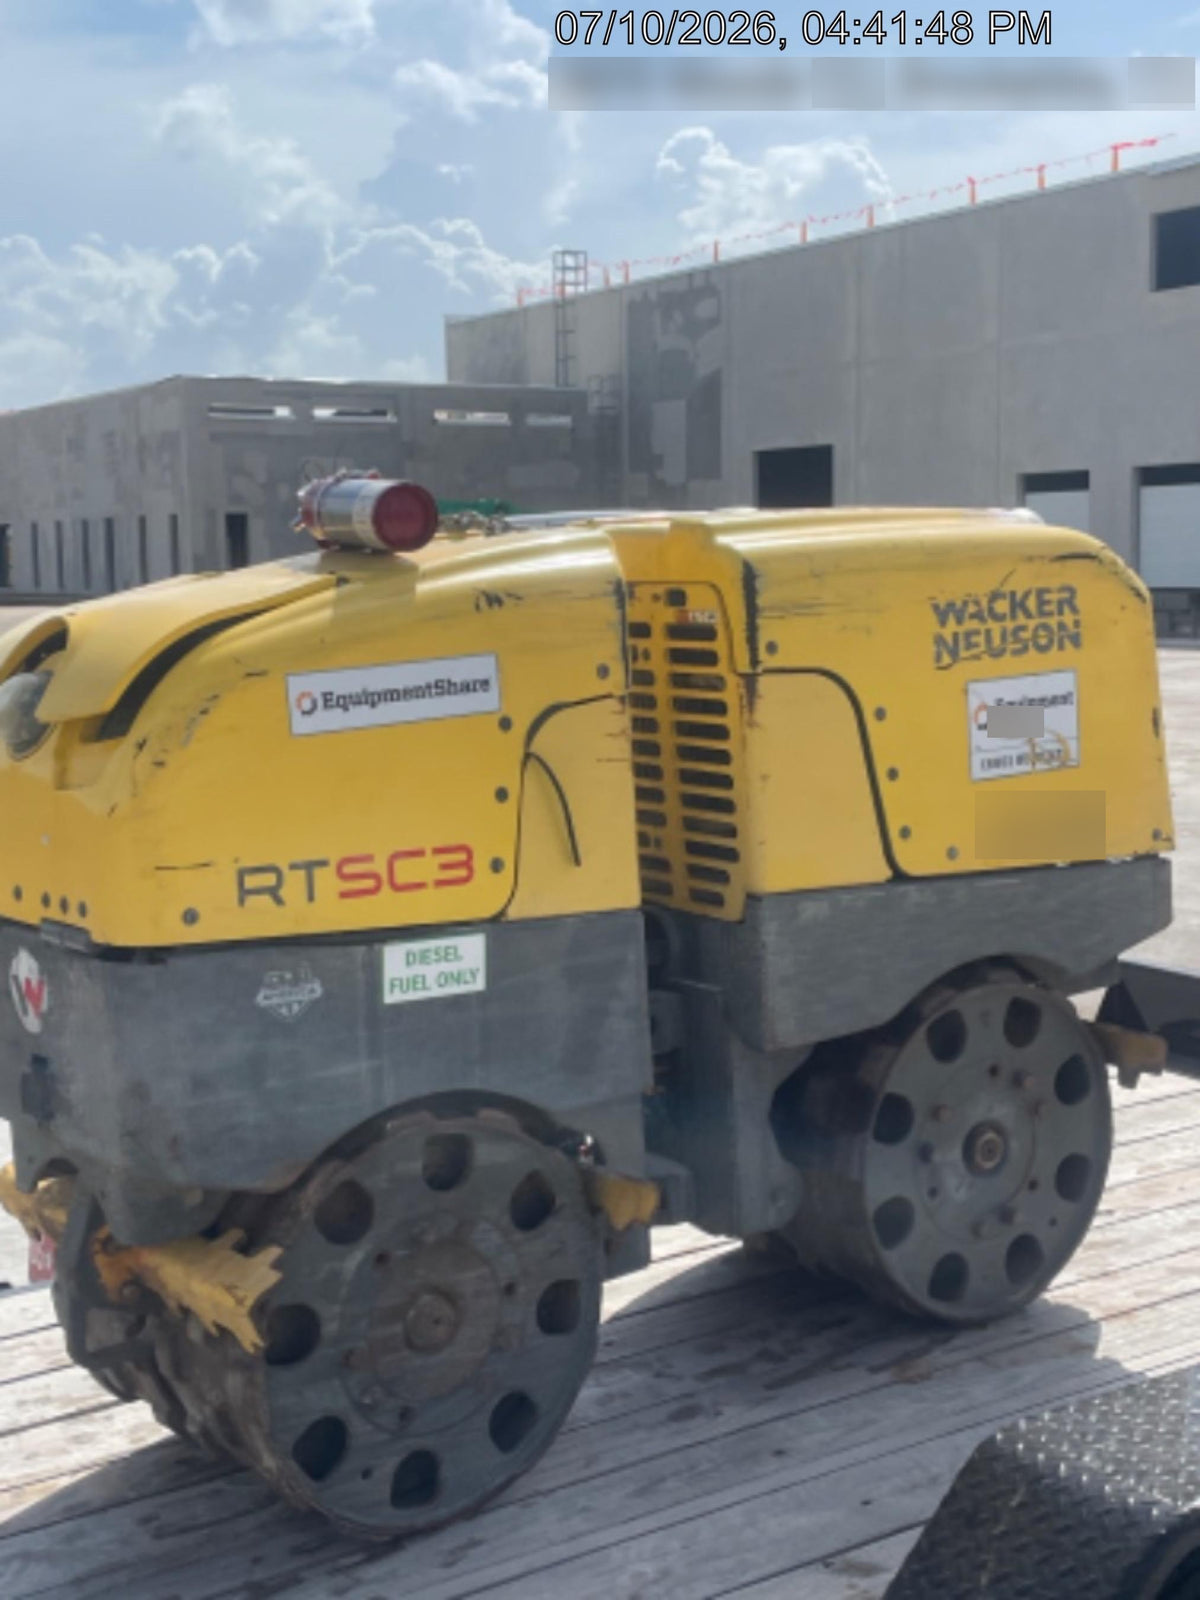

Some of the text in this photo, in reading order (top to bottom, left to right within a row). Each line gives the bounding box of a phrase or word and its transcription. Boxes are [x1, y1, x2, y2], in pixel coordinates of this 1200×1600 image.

[930, 584, 1081, 628] WACKER
[933, 619, 1082, 665] NEUSON
[320, 676, 491, 712] EquipmentShare
[237, 843, 474, 907] RTSC3
[405, 945, 464, 968] DIESEL
[389, 968, 480, 995] FUEL ONLY
